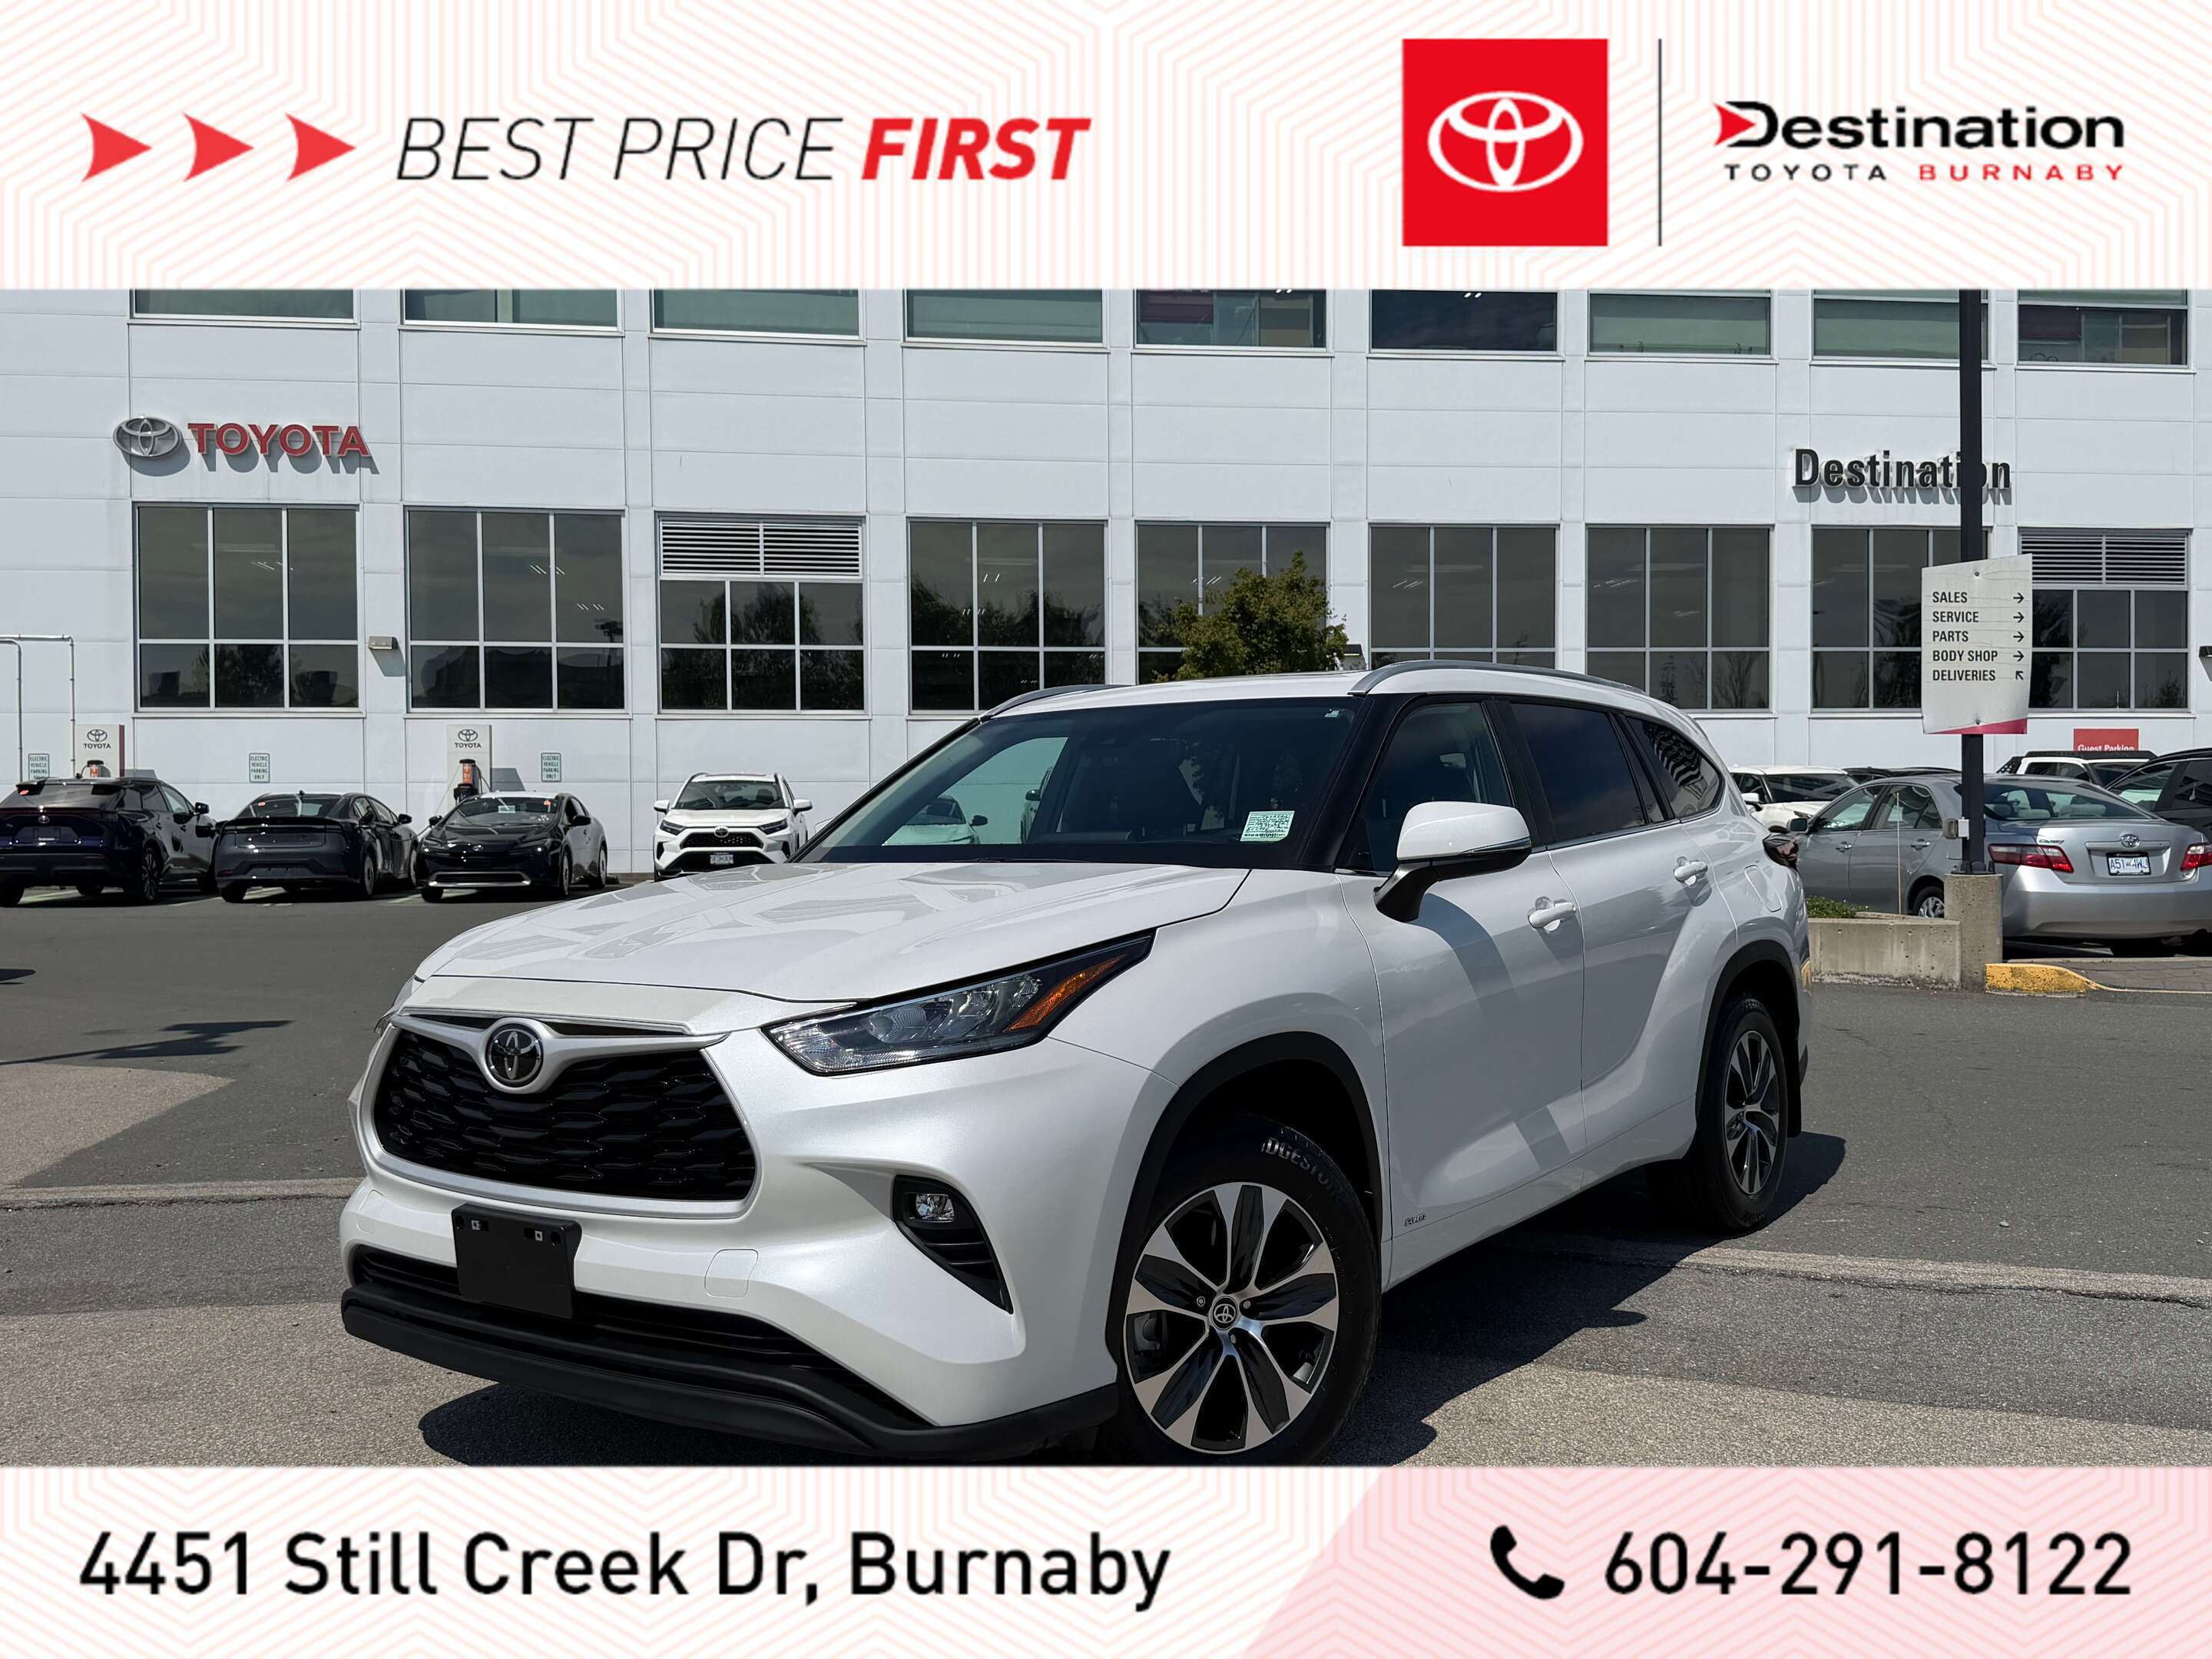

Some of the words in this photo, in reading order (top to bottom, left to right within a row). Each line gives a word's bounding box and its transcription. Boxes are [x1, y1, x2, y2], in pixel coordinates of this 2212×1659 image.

[187, 422, 370, 456] TOYOTA
[1795, 449, 2010, 488] Destinatin
[1932, 591, 1968, 603] SALES
[1932, 611, 1979, 623] SERVICE
[1932, 631, 1969, 642] PARTS
[1932, 650, 1964, 661] BODY
[1968, 650, 1998, 661] SHOP
[1932, 670, 1996, 681] DELIVERIES
